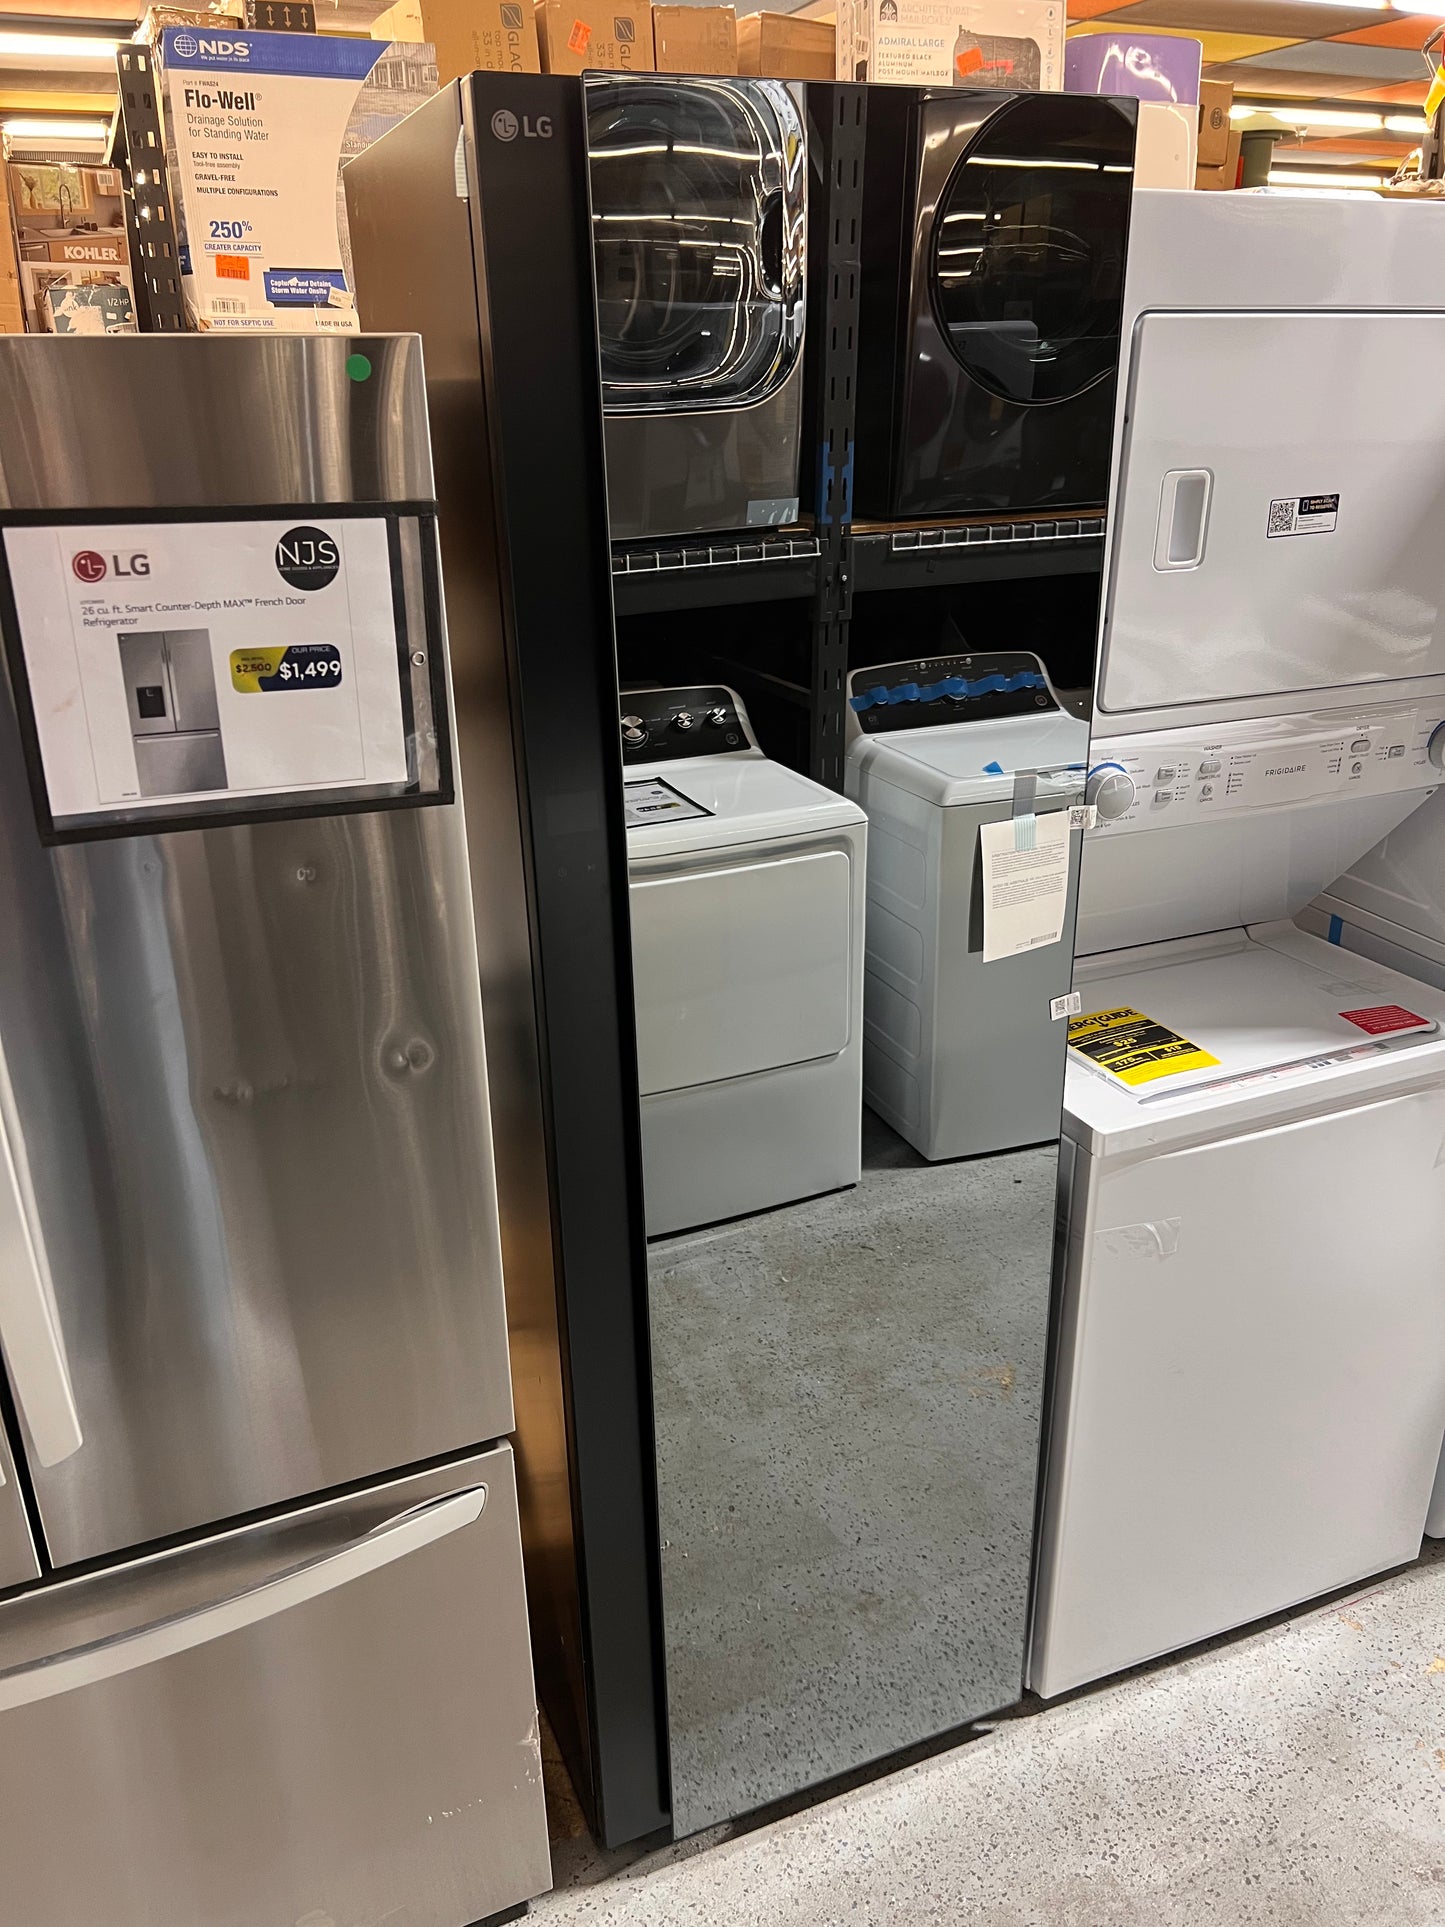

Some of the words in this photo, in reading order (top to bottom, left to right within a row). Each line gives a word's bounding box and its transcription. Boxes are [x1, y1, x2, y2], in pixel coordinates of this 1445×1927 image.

[482, 30, 492, 46] 33
[878, 36, 917, 47] ADMIRAL
[918, 39, 945, 48] LARGE
[878, 52, 911, 60] TEXTURED
[187, 113, 225, 127] Drainage
[227, 115, 264, 128] Solution
[522, 115, 553, 138] LG
[188, 127, 201, 138] for
[203, 127, 242, 141] Standing
[243, 129, 269, 141] Water
[191, 151, 208, 159] EASY
[210, 152, 218, 160] TO
[219, 153, 244, 161] INSTALL
[194, 173, 236, 182] GRAVEL-FREE
[196, 186, 227, 195] MULTIPLE
[227, 188, 279, 197] CONFIGURATIONS
[209, 220, 253, 239] 250%
[204, 243, 232, 251] GREATER
[232, 244, 262, 252] CAPACITY
[308, 287, 328, 295] Onsite
[107, 298, 119, 307] 1/2
[119, 298, 129, 306] HP
[262, 319, 275, 327] USE
[278, 540, 336, 566] NJS
[112, 553, 151, 577] LG
[81, 606, 95, 616] 26
[112, 604, 123, 614] ft.
[125, 604, 153, 613] Smart
[155, 601, 221, 612] Counter-Depth
[255, 597, 284, 607] French
[285, 597, 306, 606] Door
[83, 617, 139, 628] Refrigerator
[279, 660, 341, 681] $1,499
[1264, 764, 1307, 777] FRIGIDAIRE
